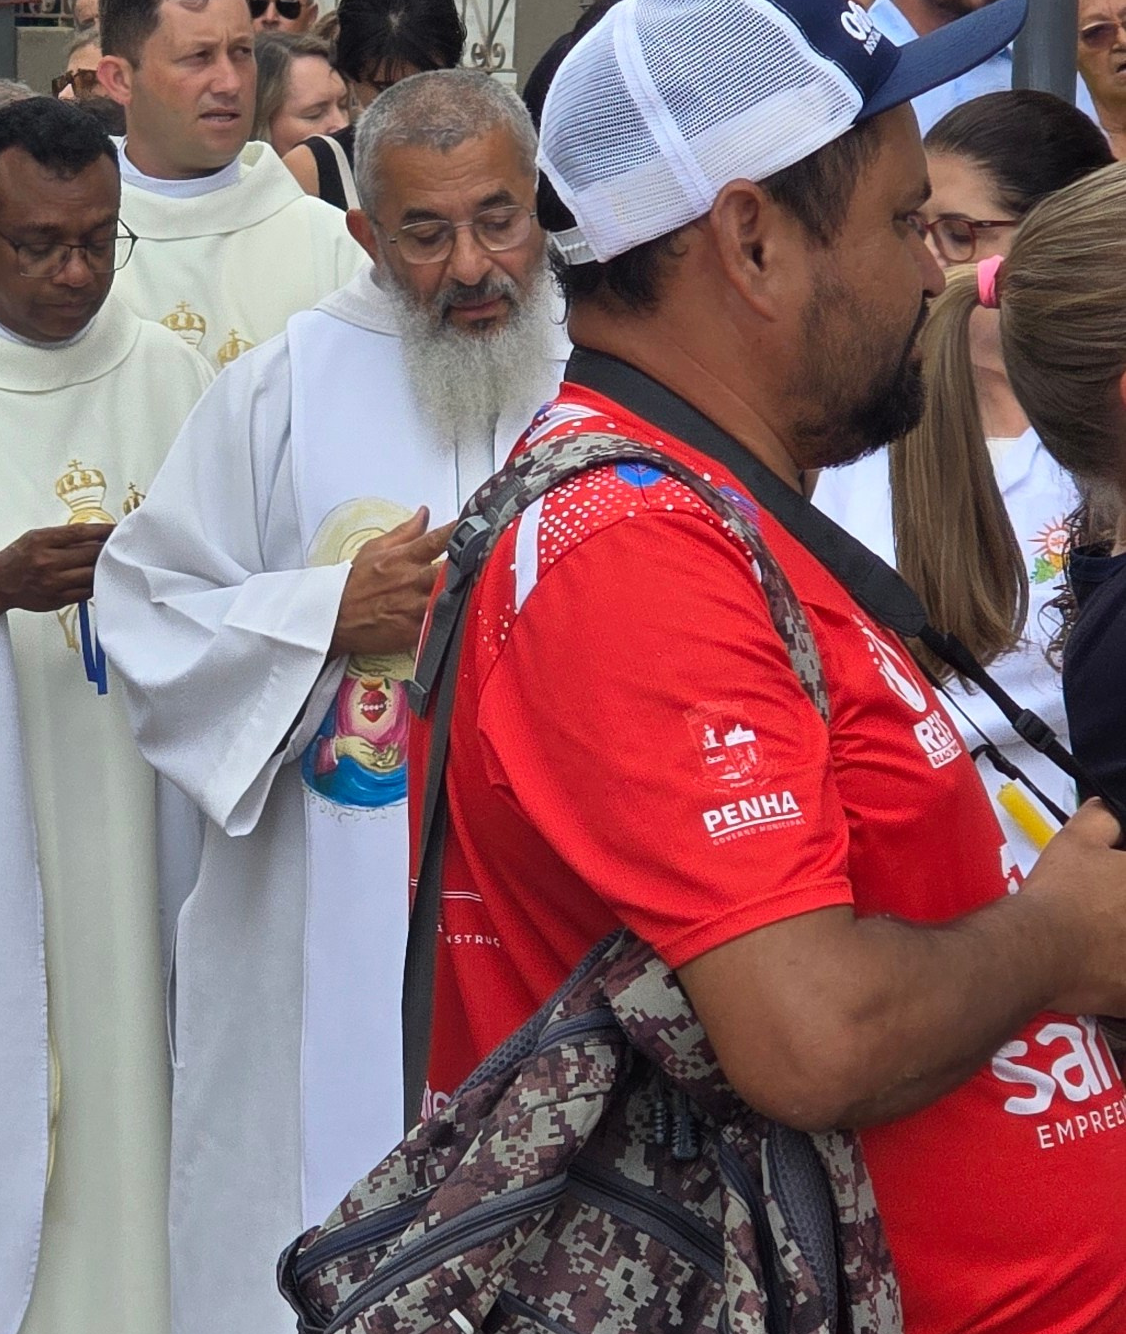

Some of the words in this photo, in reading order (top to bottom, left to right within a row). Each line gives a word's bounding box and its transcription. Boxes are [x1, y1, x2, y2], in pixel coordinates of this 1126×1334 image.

[702, 790, 800, 832] PENHA
[712, 828, 757, 846] GOVERNO
[759, 818, 807, 833] MUNICIPAL
